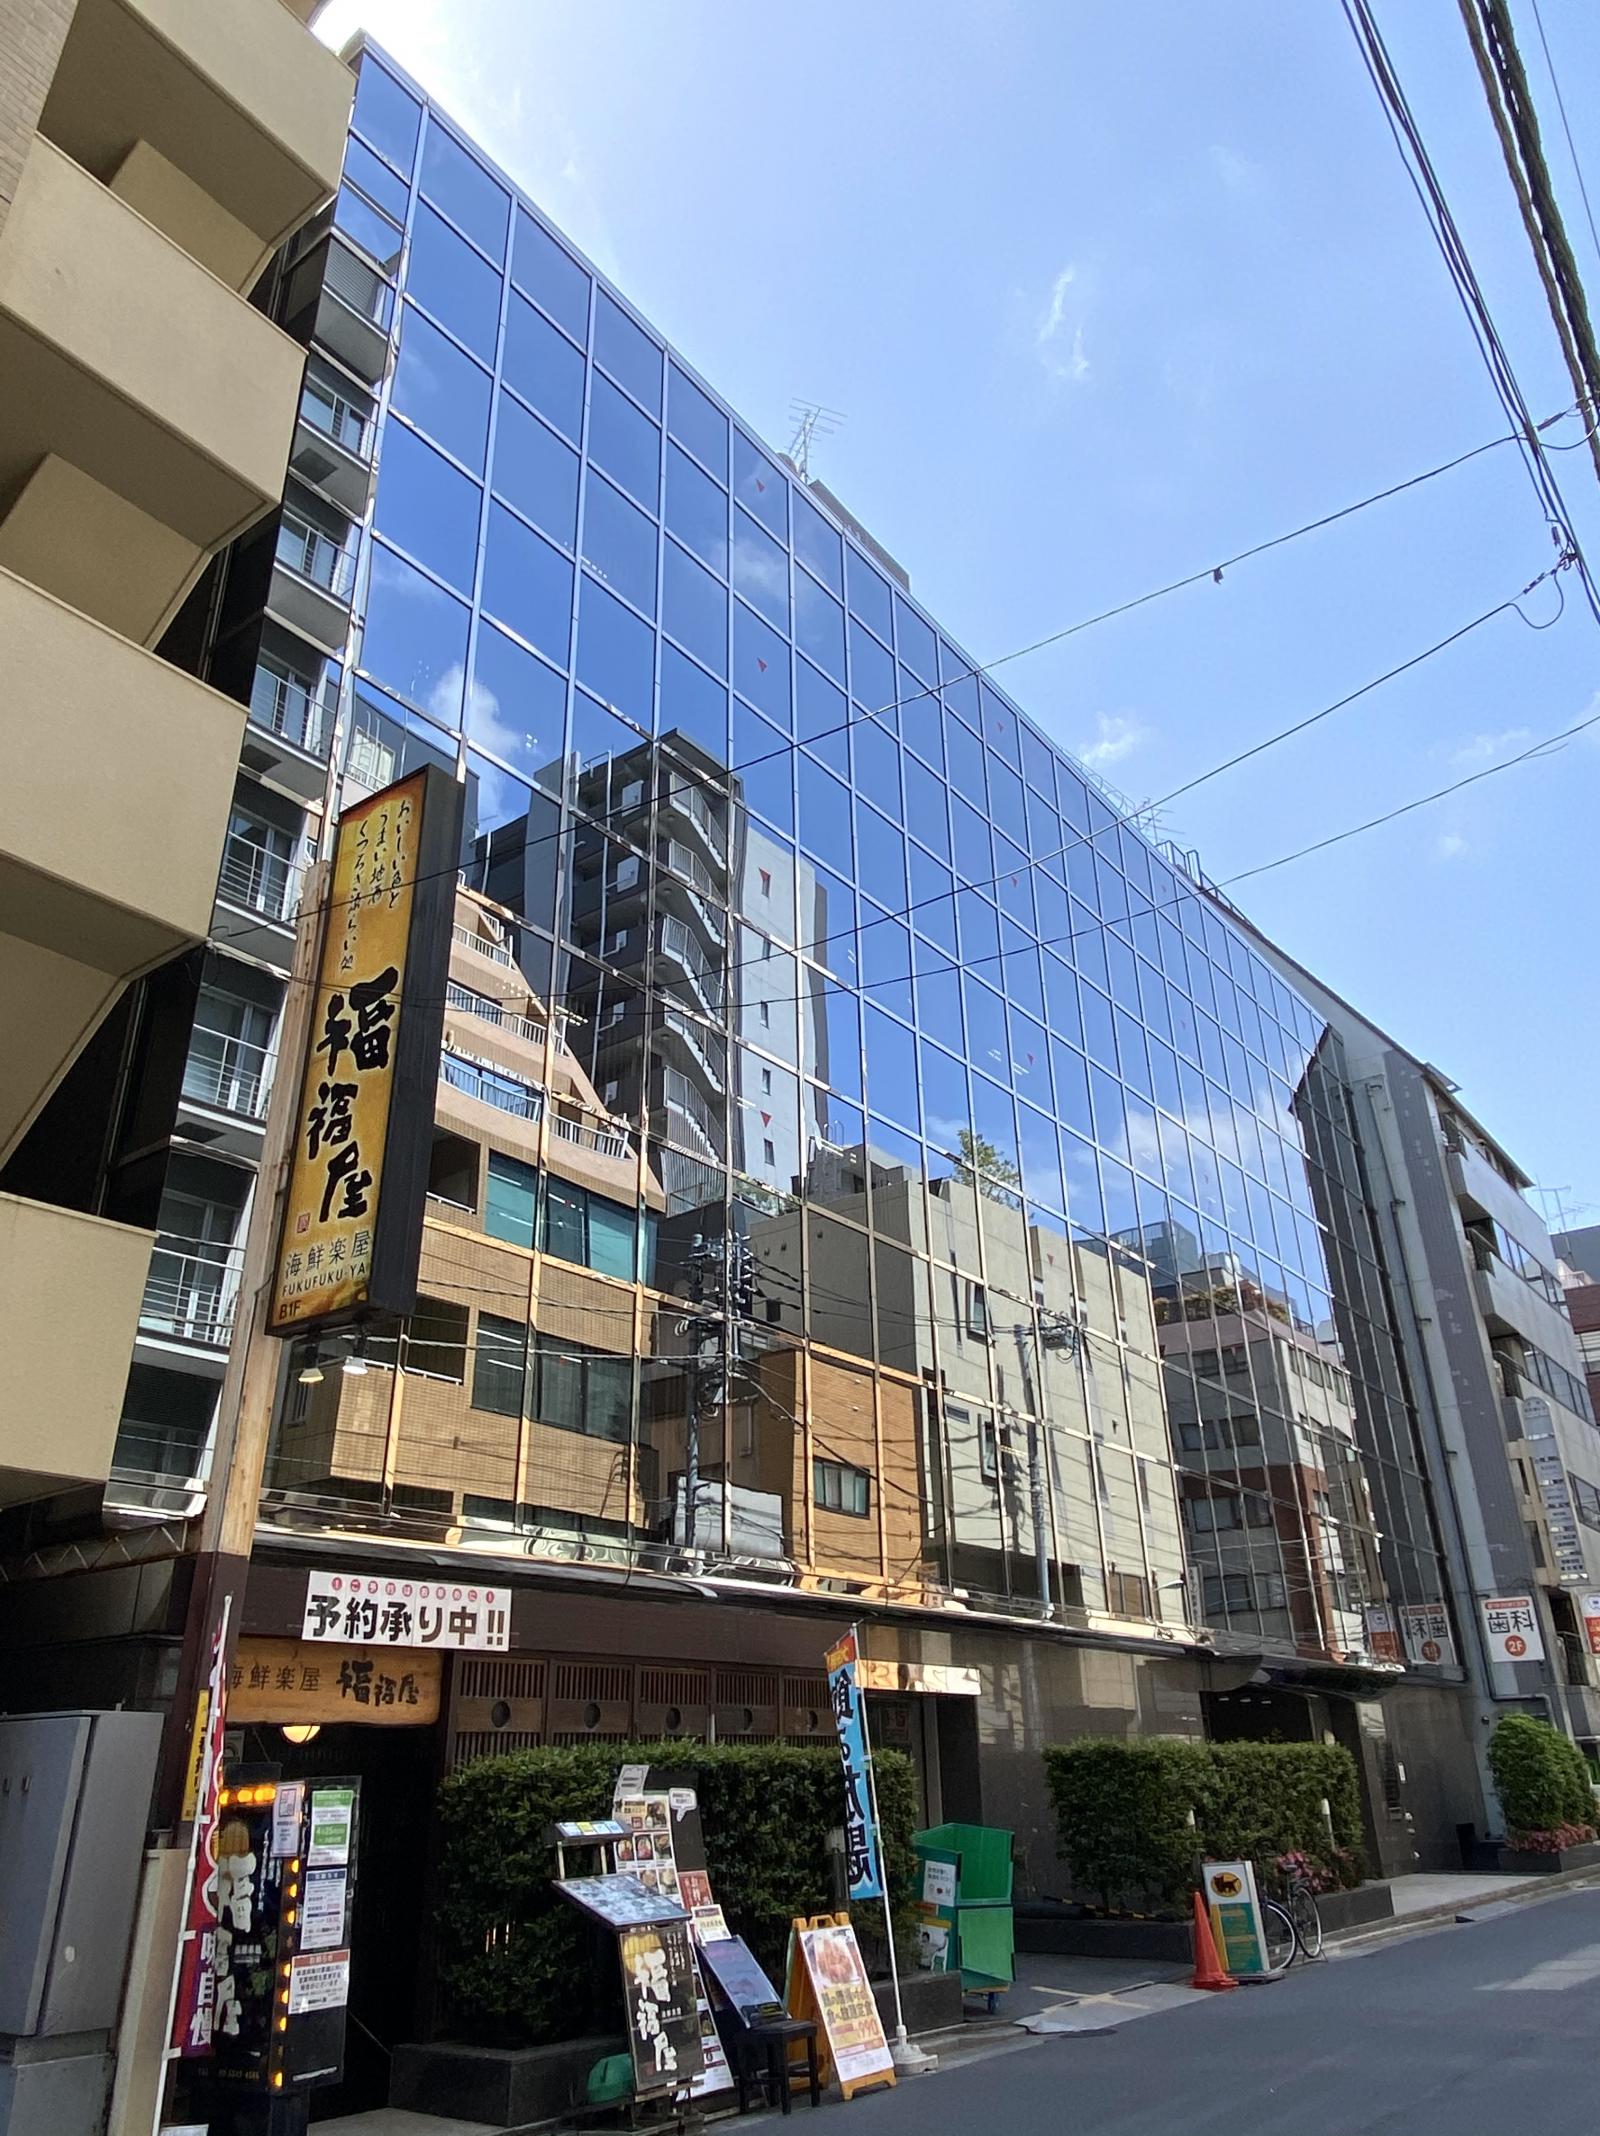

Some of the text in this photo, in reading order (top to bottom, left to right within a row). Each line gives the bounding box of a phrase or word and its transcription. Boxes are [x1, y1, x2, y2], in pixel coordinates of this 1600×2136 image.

[306, 966, 400, 1224] 福福屋
[285, 1230, 371, 1281] 海鮮楽屋
[278, 1300, 302, 1320] B1F
[1487, 1608, 1535, 1634] 歯科
[1508, 1640, 1523, 1653] 2F
[230, 1659, 420, 1707] 海鮮楽屋 福福屋
